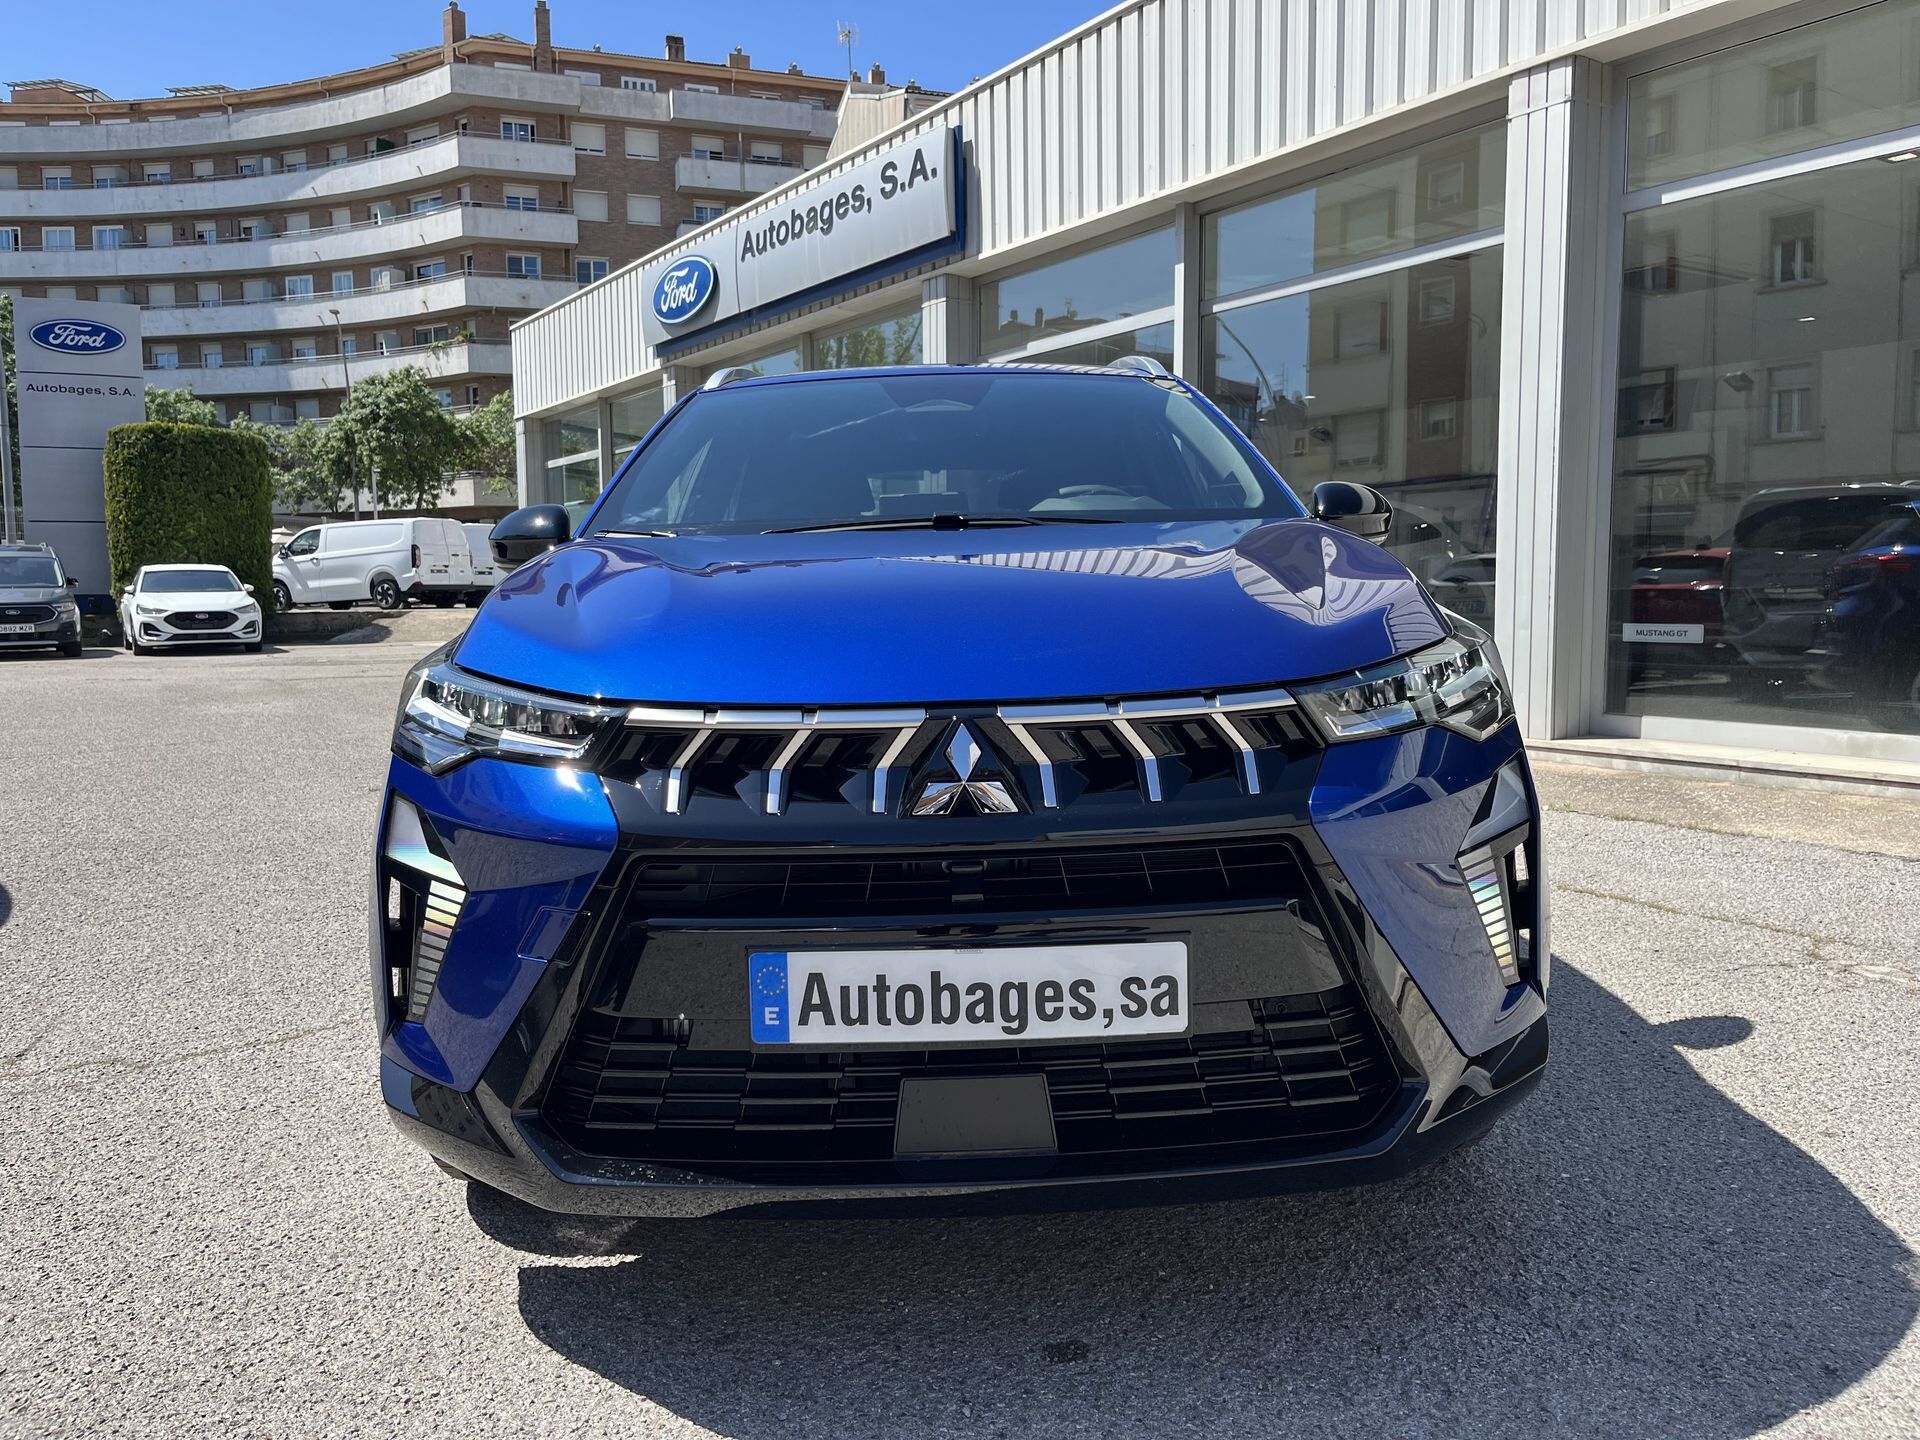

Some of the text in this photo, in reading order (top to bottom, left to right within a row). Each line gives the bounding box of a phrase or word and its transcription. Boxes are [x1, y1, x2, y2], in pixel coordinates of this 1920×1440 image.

[740, 148, 938, 263] Autobages, S.A.
[661, 267, 698, 313] Ford
[49, 323, 105, 348] Ford
[26, 383, 136, 397] Autobages, S.A.
[1635, 629, 1675, 637] MUSTANG
[797, 970, 1180, 1035] Autobages,sa
[764, 1006, 780, 1025] E
